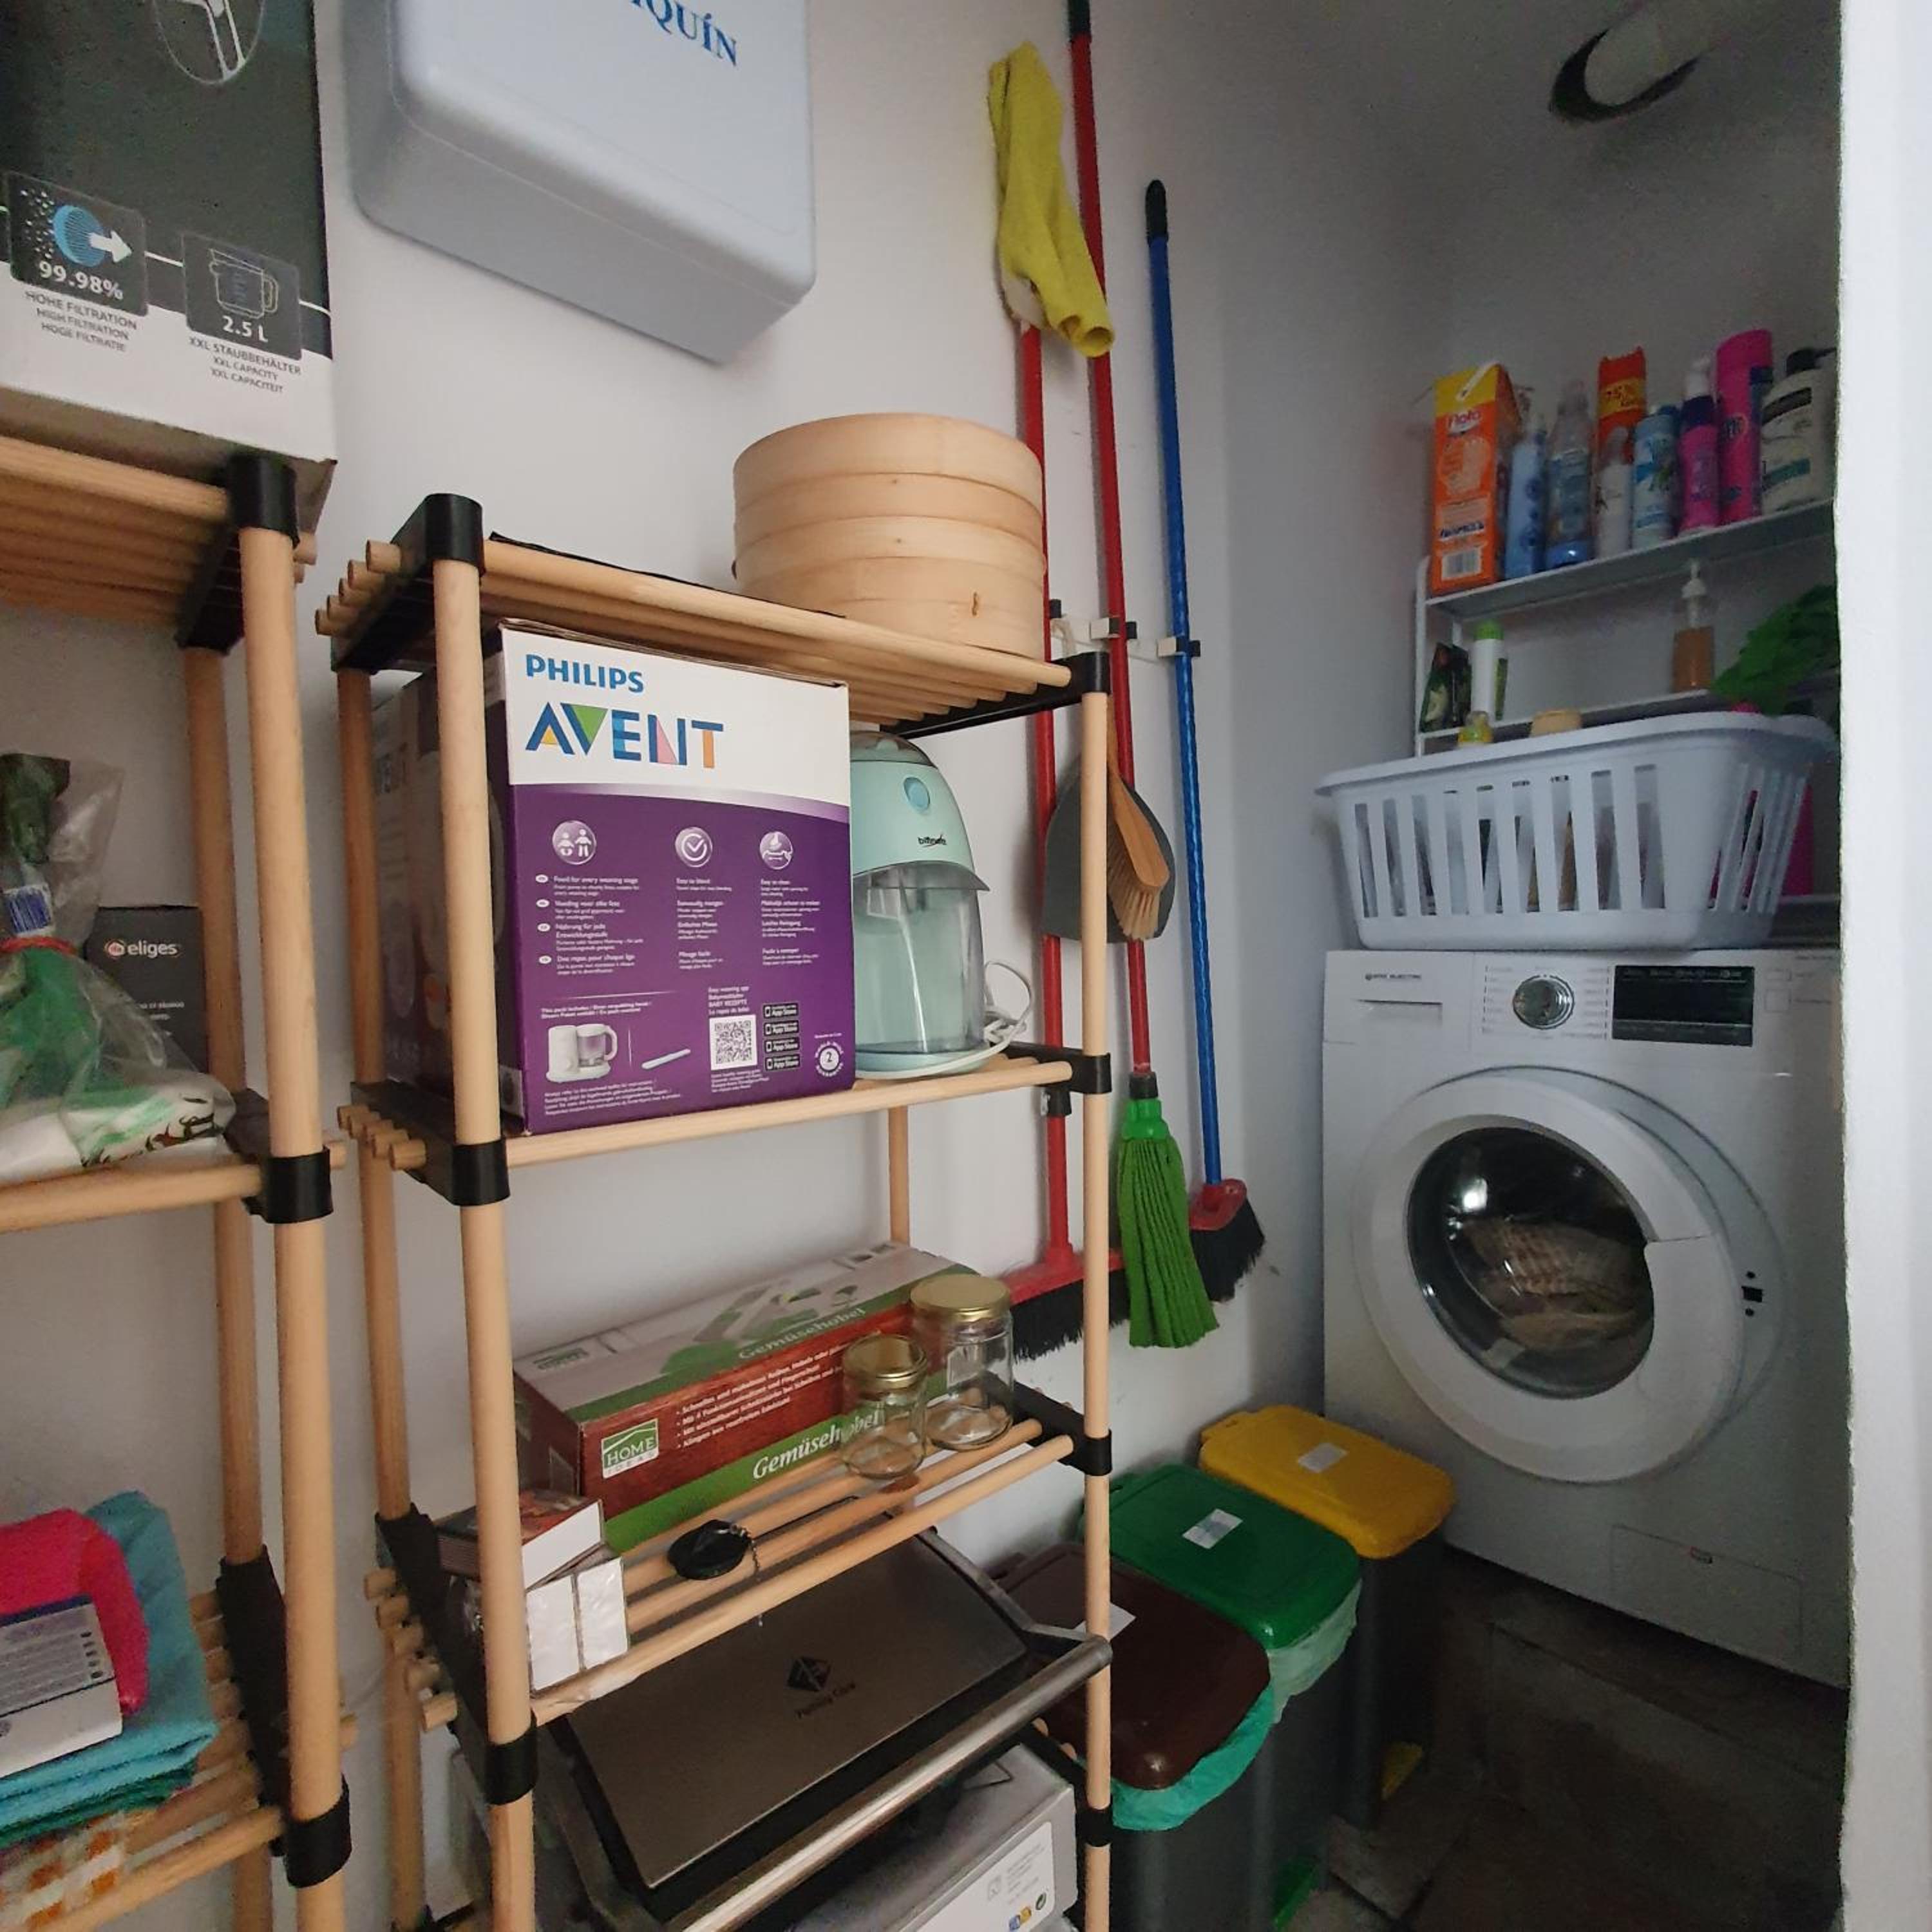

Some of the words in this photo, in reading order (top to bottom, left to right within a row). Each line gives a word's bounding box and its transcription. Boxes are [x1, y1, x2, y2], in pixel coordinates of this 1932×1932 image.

[630, 0, 737, 66] QUÍN
[39, 260, 124, 300] 99.98%
[25, 290, 63, 309] HOHE
[66, 301, 137, 330] FILTRATION
[36, 307, 66, 323] HIGH
[67, 316, 129, 340] FILTRATION
[41, 322, 73, 338] HOGE
[75, 330, 126, 352] FILTRATIE
[222, 315, 252, 337] 2.5
[258, 324, 269, 343] L
[189, 336, 211, 350] XXL
[213, 343, 301, 375] STAUBBEHÄLTER
[213, 355, 232, 368] XXL
[232, 361, 278, 381] CAPACITY
[210, 366, 229, 379] XXL
[231, 373, 283, 392] CAPACITEIT
[525, 654, 645, 694] PHILIPS
[525, 701, 724, 769] AVENT
[127, 940, 178, 959] eliges
[826, 1050, 833, 1063] 2
[738, 1307, 866, 1359] Gemüsehobel
[607, 1437, 655, 1466] HOME
